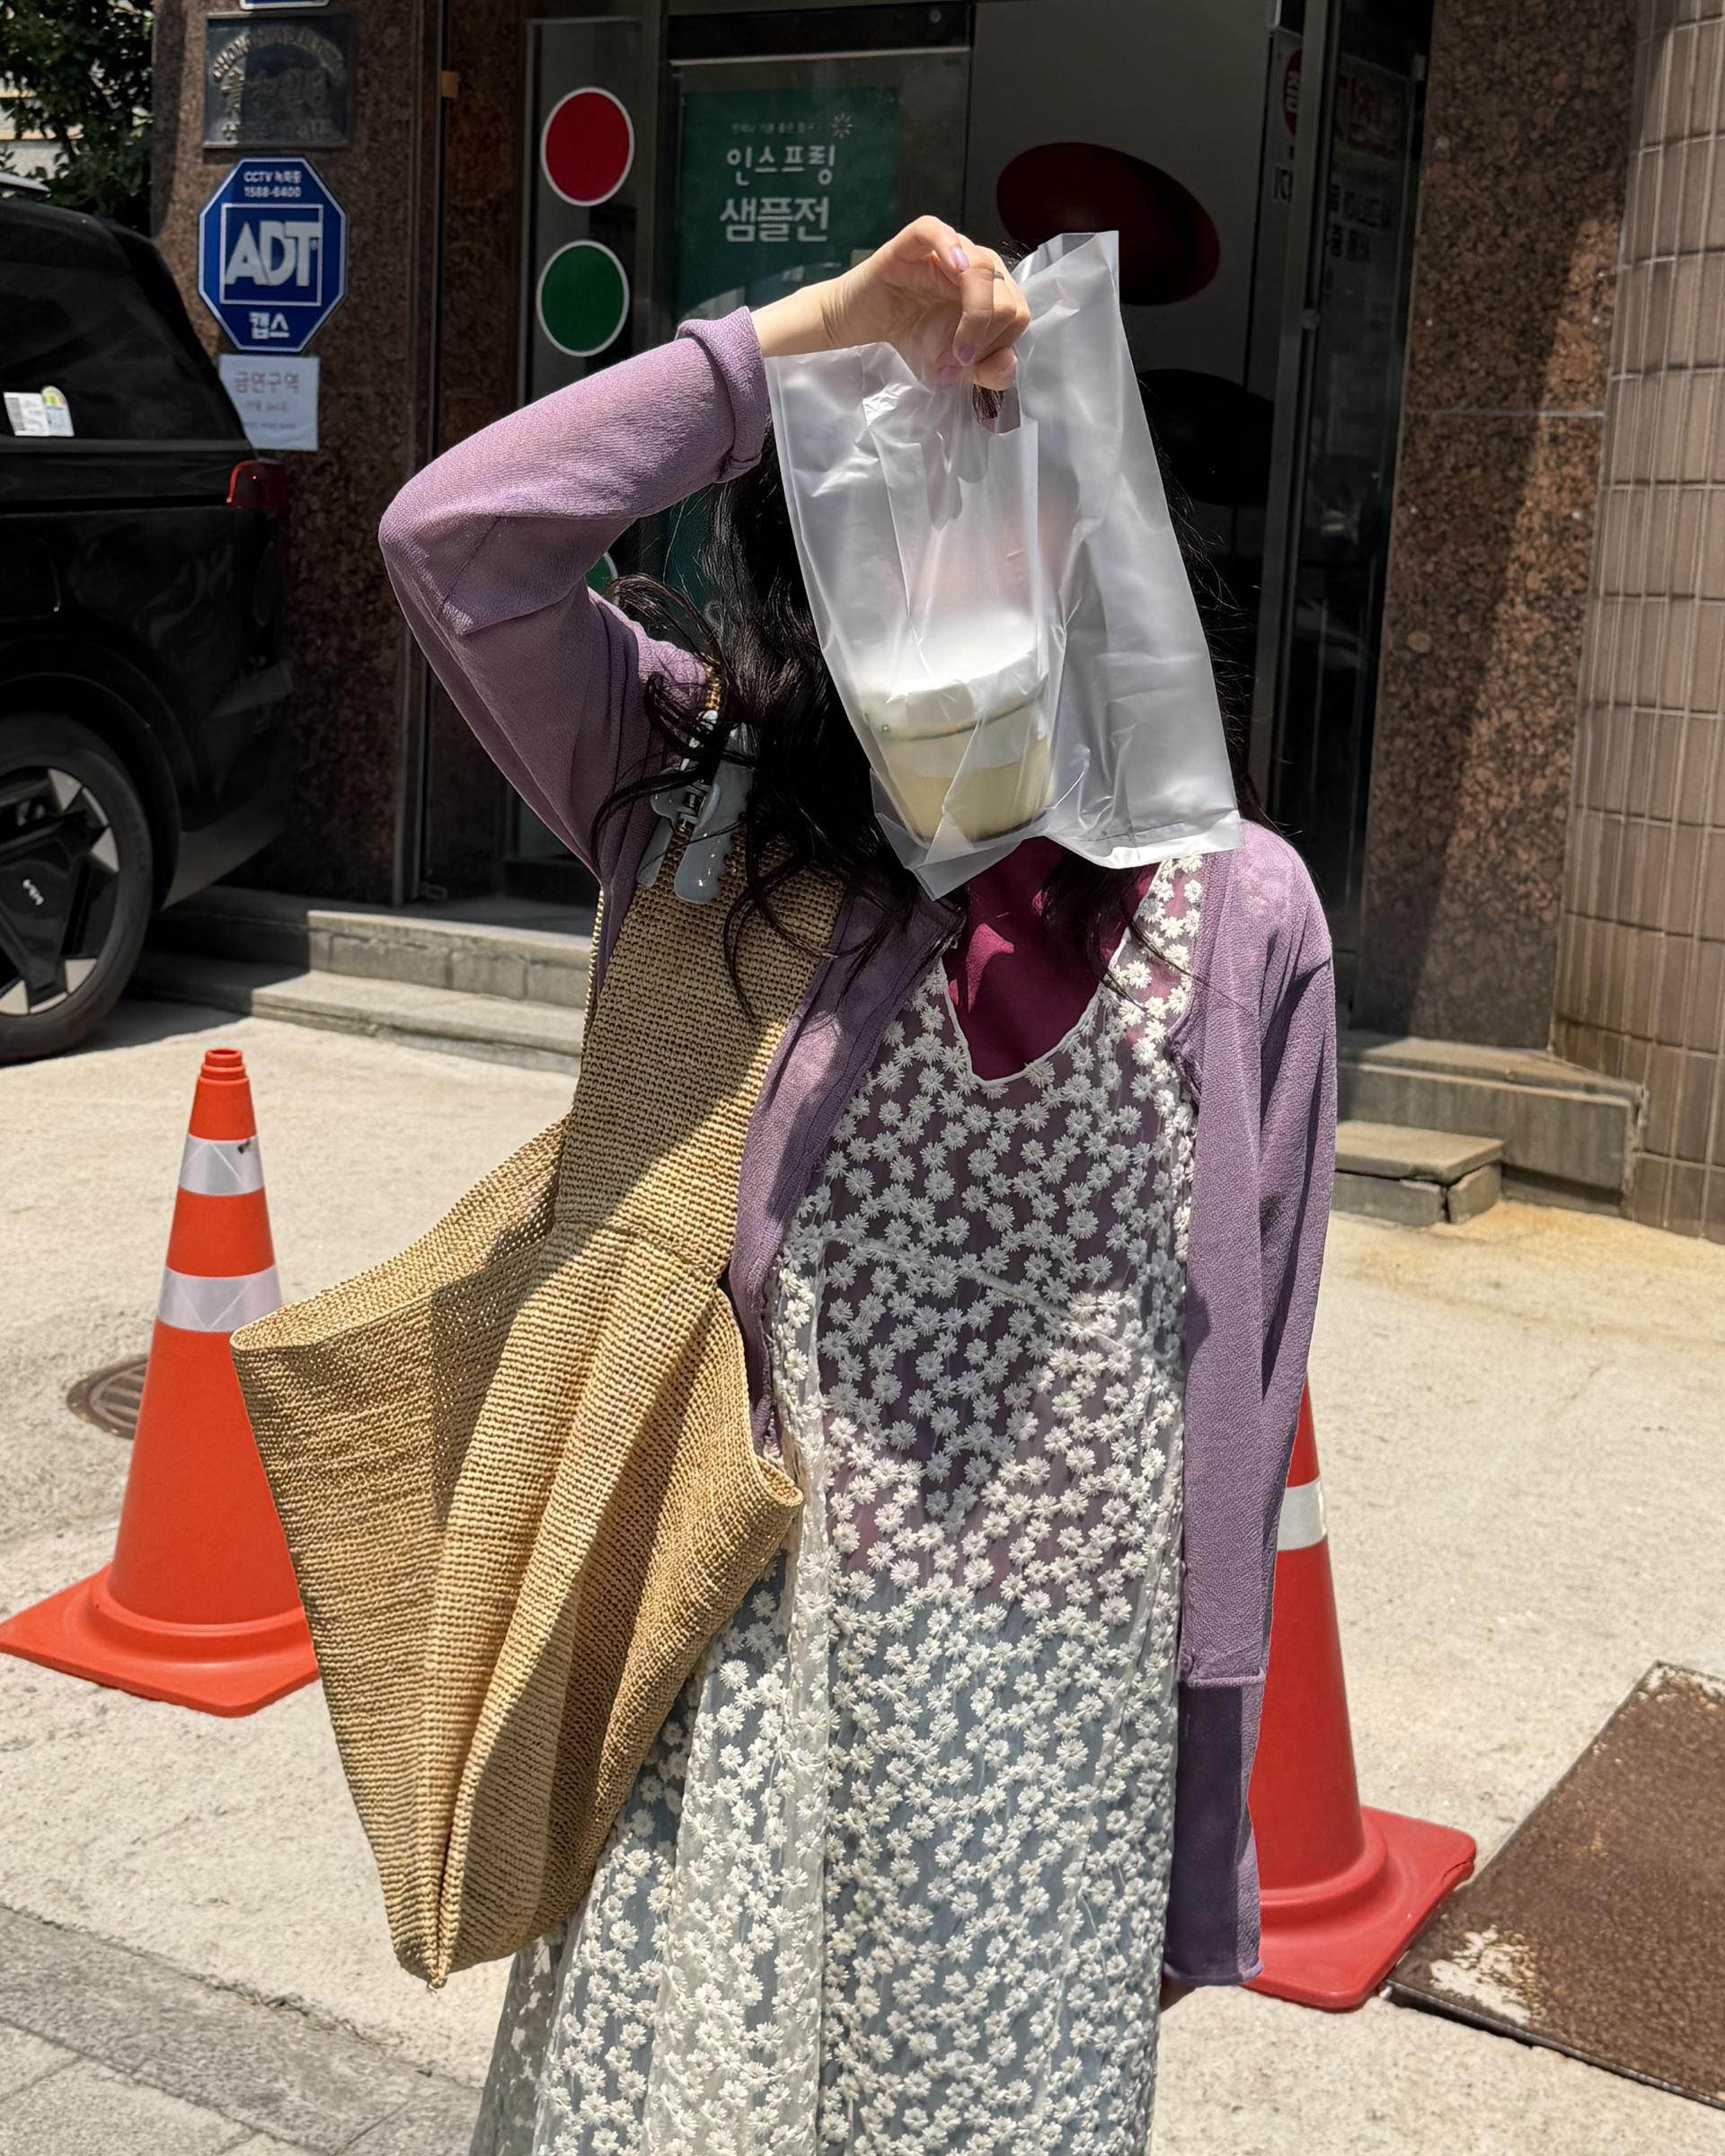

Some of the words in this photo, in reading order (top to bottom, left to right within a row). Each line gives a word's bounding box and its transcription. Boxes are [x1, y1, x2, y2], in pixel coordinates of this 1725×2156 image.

[243, 171, 273, 182] CCTV
[726, 144, 836, 186] 인스프링
[720, 197, 829, 243] 샘플전
[226, 220, 321, 287] ADT
[249, 312, 290, 340] 캡스
[234, 371, 300, 393] 금연구역
